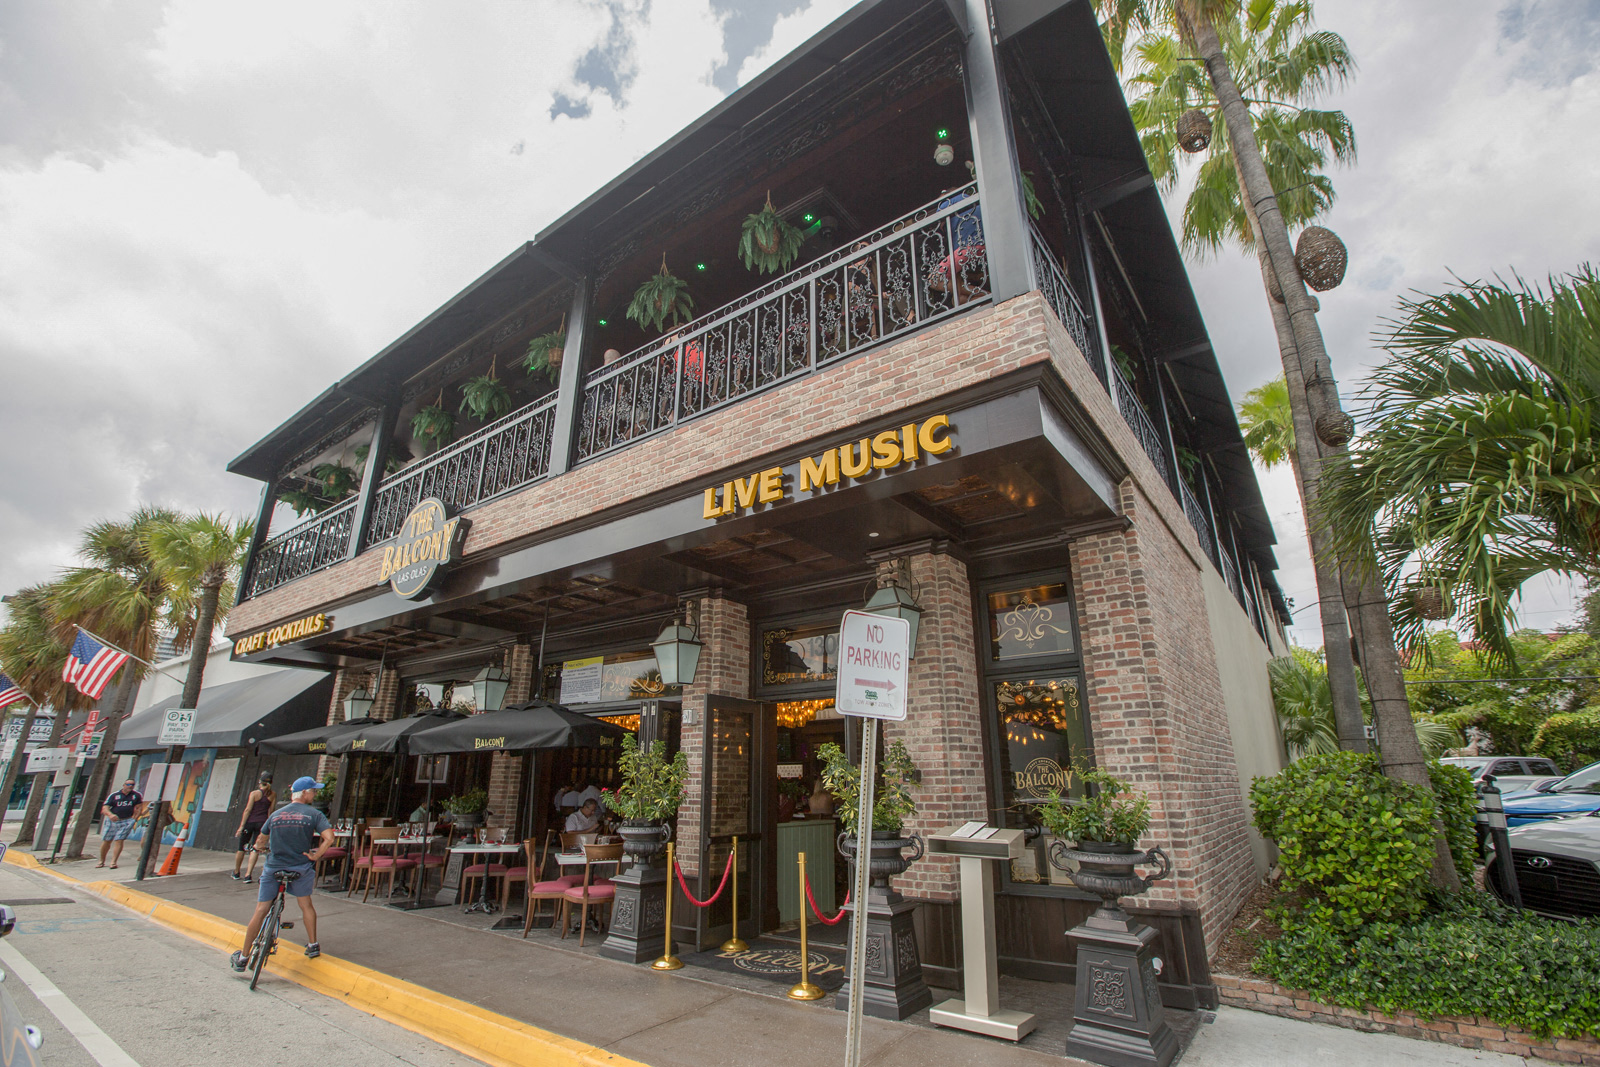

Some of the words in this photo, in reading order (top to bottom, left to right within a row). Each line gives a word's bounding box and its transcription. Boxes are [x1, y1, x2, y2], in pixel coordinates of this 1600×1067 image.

[703, 466, 783, 519] LIVE
[799, 414, 952, 492] MUSIC
[410, 505, 437, 538] THE
[380, 520, 457, 581] BALCONY
[397, 571, 410, 584] LAS
[410, 565, 428, 580] OLAS
[234, 631, 267, 655] CRAFT
[267, 613, 325, 645] COCKTAILS
[807, 634, 840, 657] 130
[866, 624, 884, 644] NO
[847, 646, 901, 671] PARKING
[308, 742, 327, 752] BALCO
[474, 736, 505, 749] BALCONY
[1015, 770, 1073, 789] BALCONY
[714, 950, 844, 976] BALCONY
